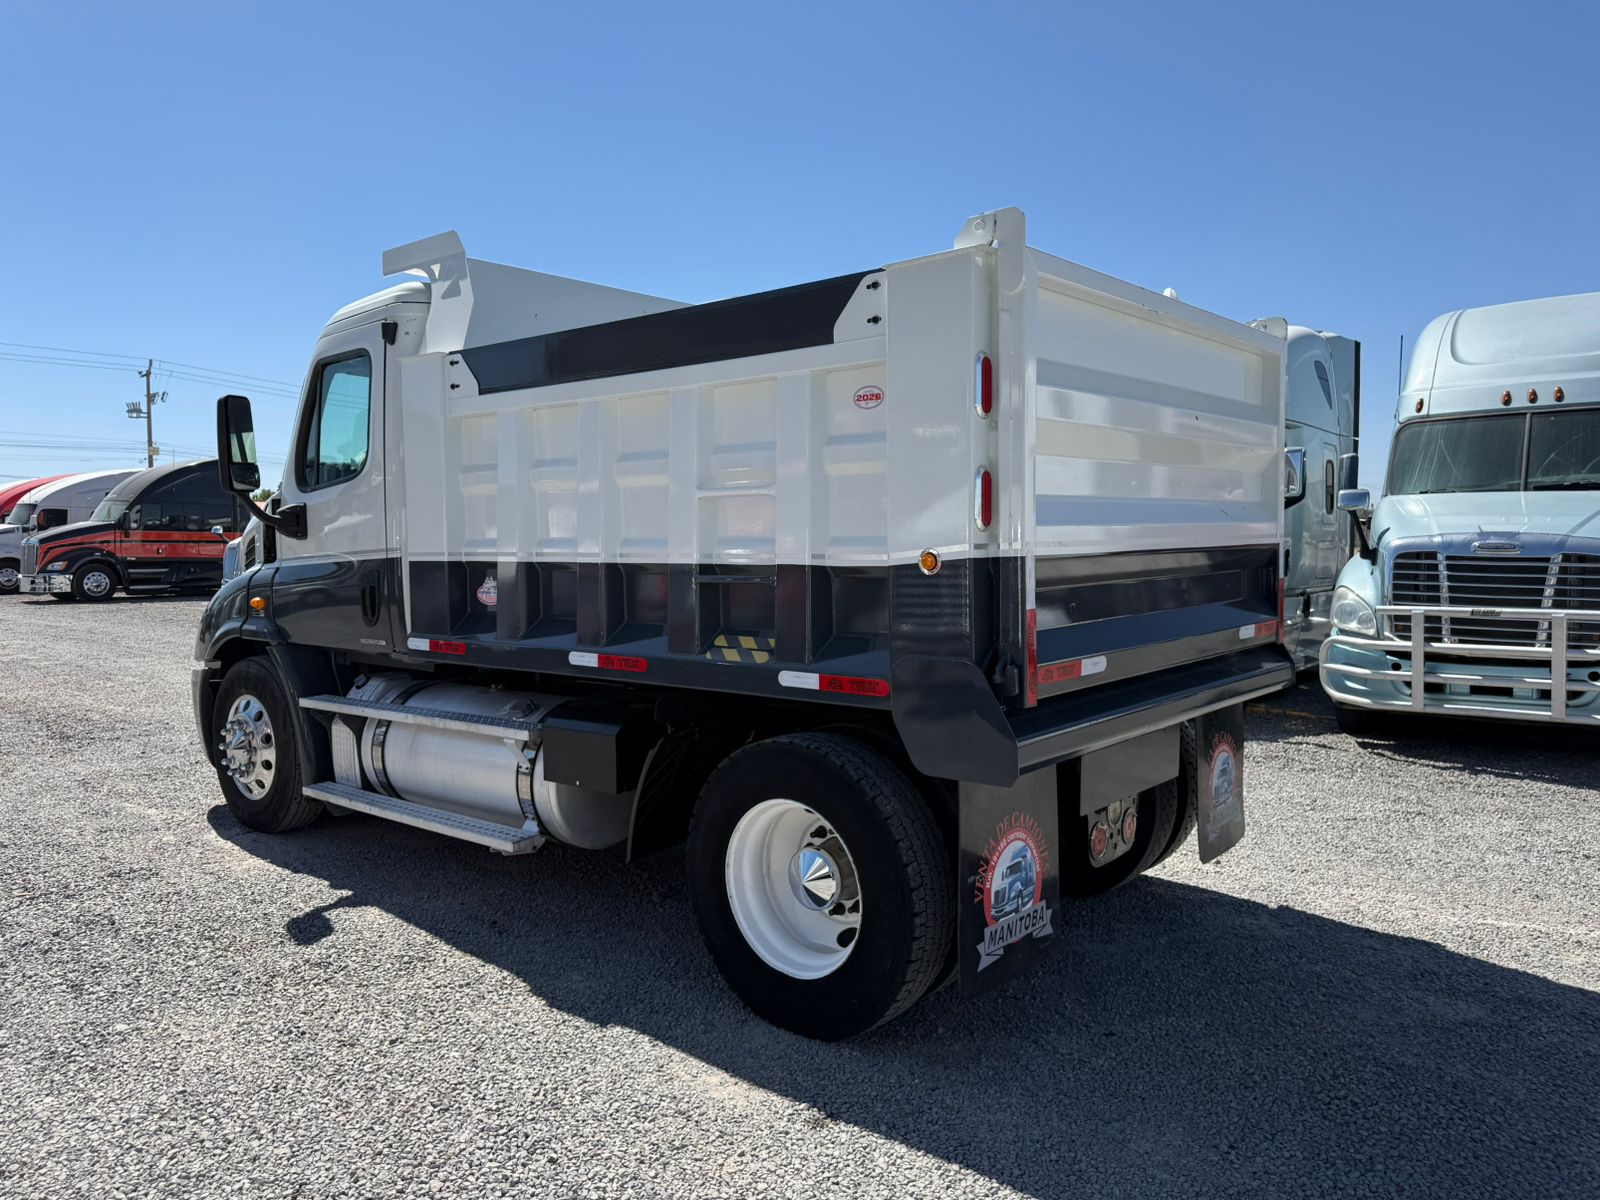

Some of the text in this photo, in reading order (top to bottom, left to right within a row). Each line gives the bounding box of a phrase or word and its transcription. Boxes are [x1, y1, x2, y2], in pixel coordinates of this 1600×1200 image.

[856, 393, 882, 402] 2026
[974, 811, 1050, 904] VENTA DE CAMIONES
[987, 907, 1045, 950] MANITOBA
